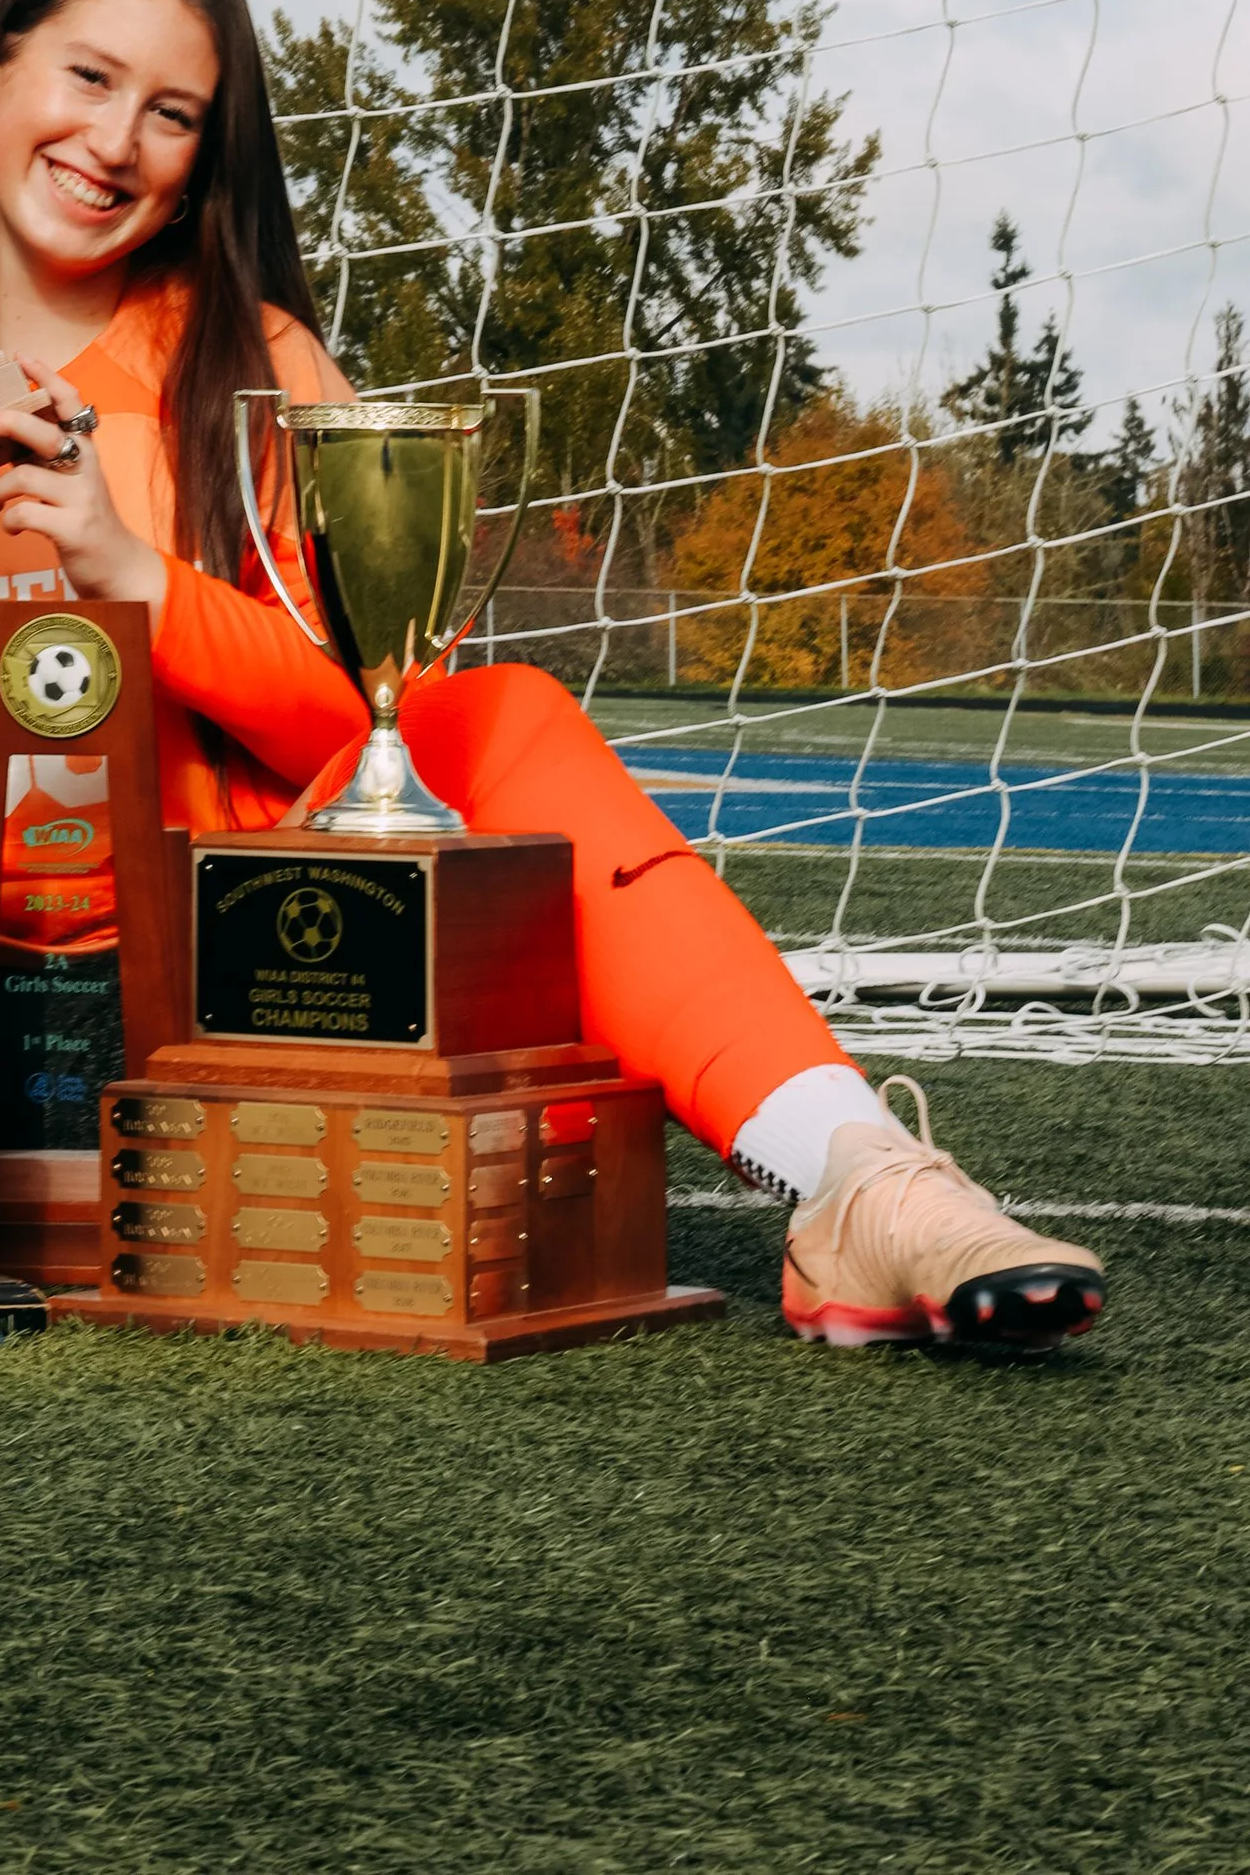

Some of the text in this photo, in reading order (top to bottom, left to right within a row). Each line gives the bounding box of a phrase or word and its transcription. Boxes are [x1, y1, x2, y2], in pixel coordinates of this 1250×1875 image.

[216, 866, 407, 915] SOUTHWEST WASHINGTON
[24, 894, 91, 912] 2023-24
[44, 953, 70, 970] 2A
[4, 976, 110, 994] Girls Soccer
[254, 969, 287, 982] WIAA
[289, 970, 349, 986] DISTRICT
[249, 988, 372, 1008] GIRLS SOCCER
[252, 1008, 370, 1032] CHAMPIONS
[45, 1033, 92, 1052] Place
